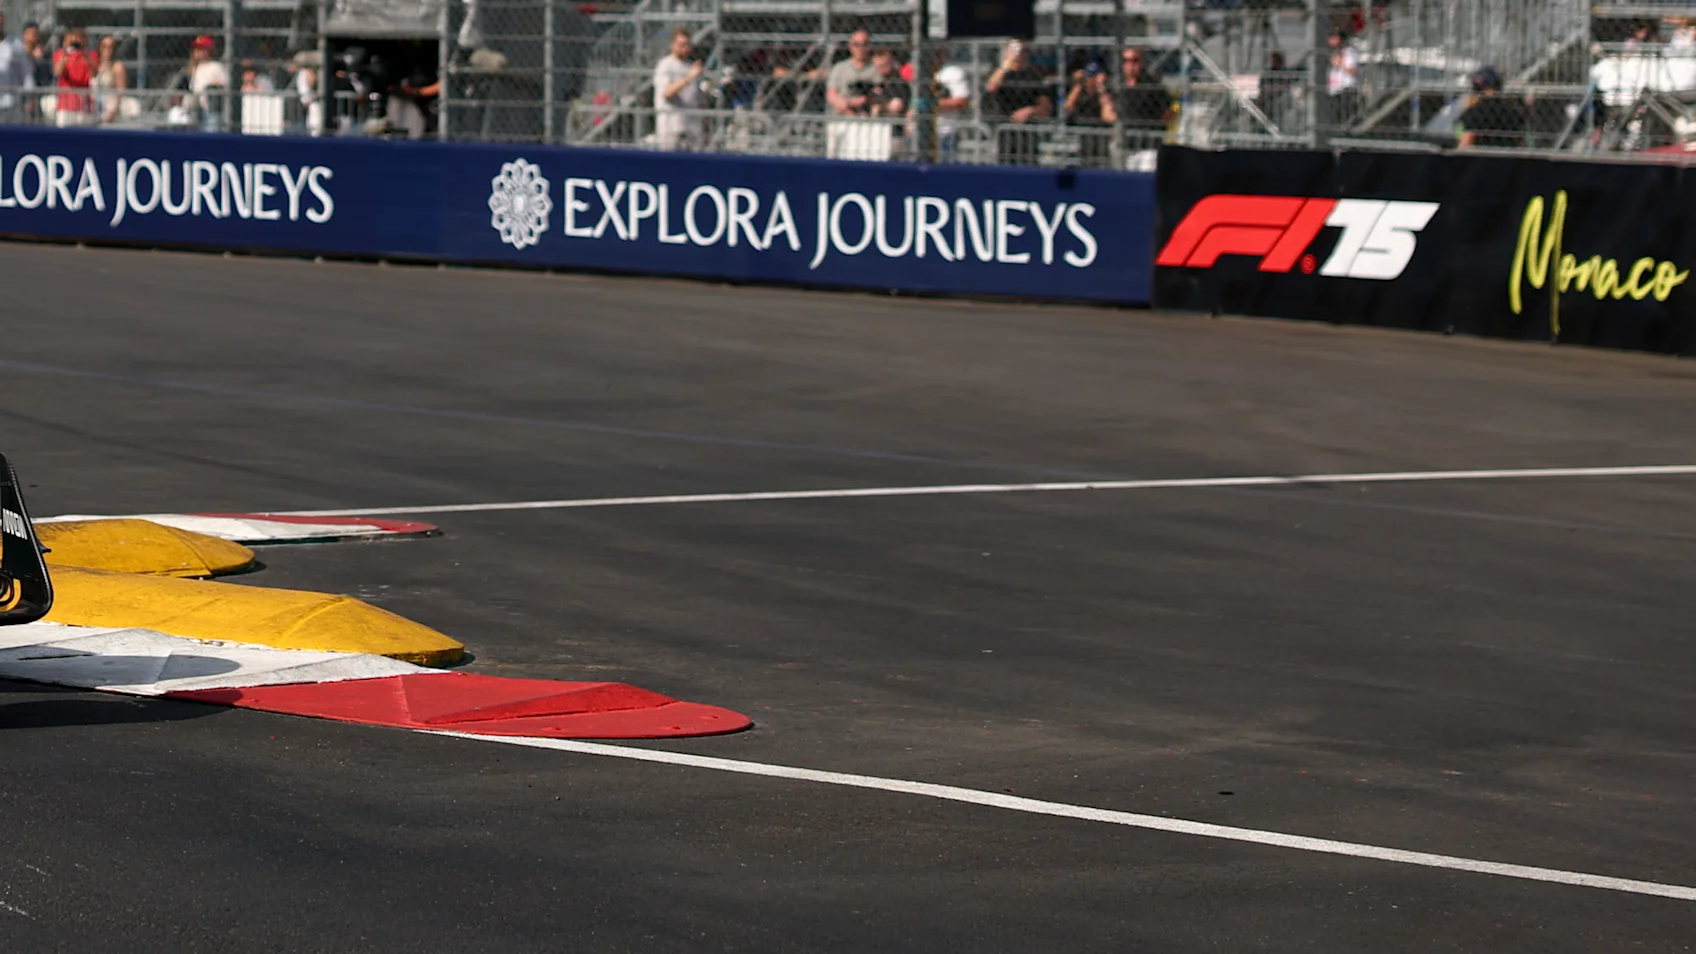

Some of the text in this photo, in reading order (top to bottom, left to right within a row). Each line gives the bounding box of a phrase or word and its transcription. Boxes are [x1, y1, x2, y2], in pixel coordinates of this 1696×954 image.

[110, 157, 334, 227] JOURNEYS
[564, 177, 1096, 269] EXPLORA JOURNEYS
[1510, 189, 1690, 333] Monaco
